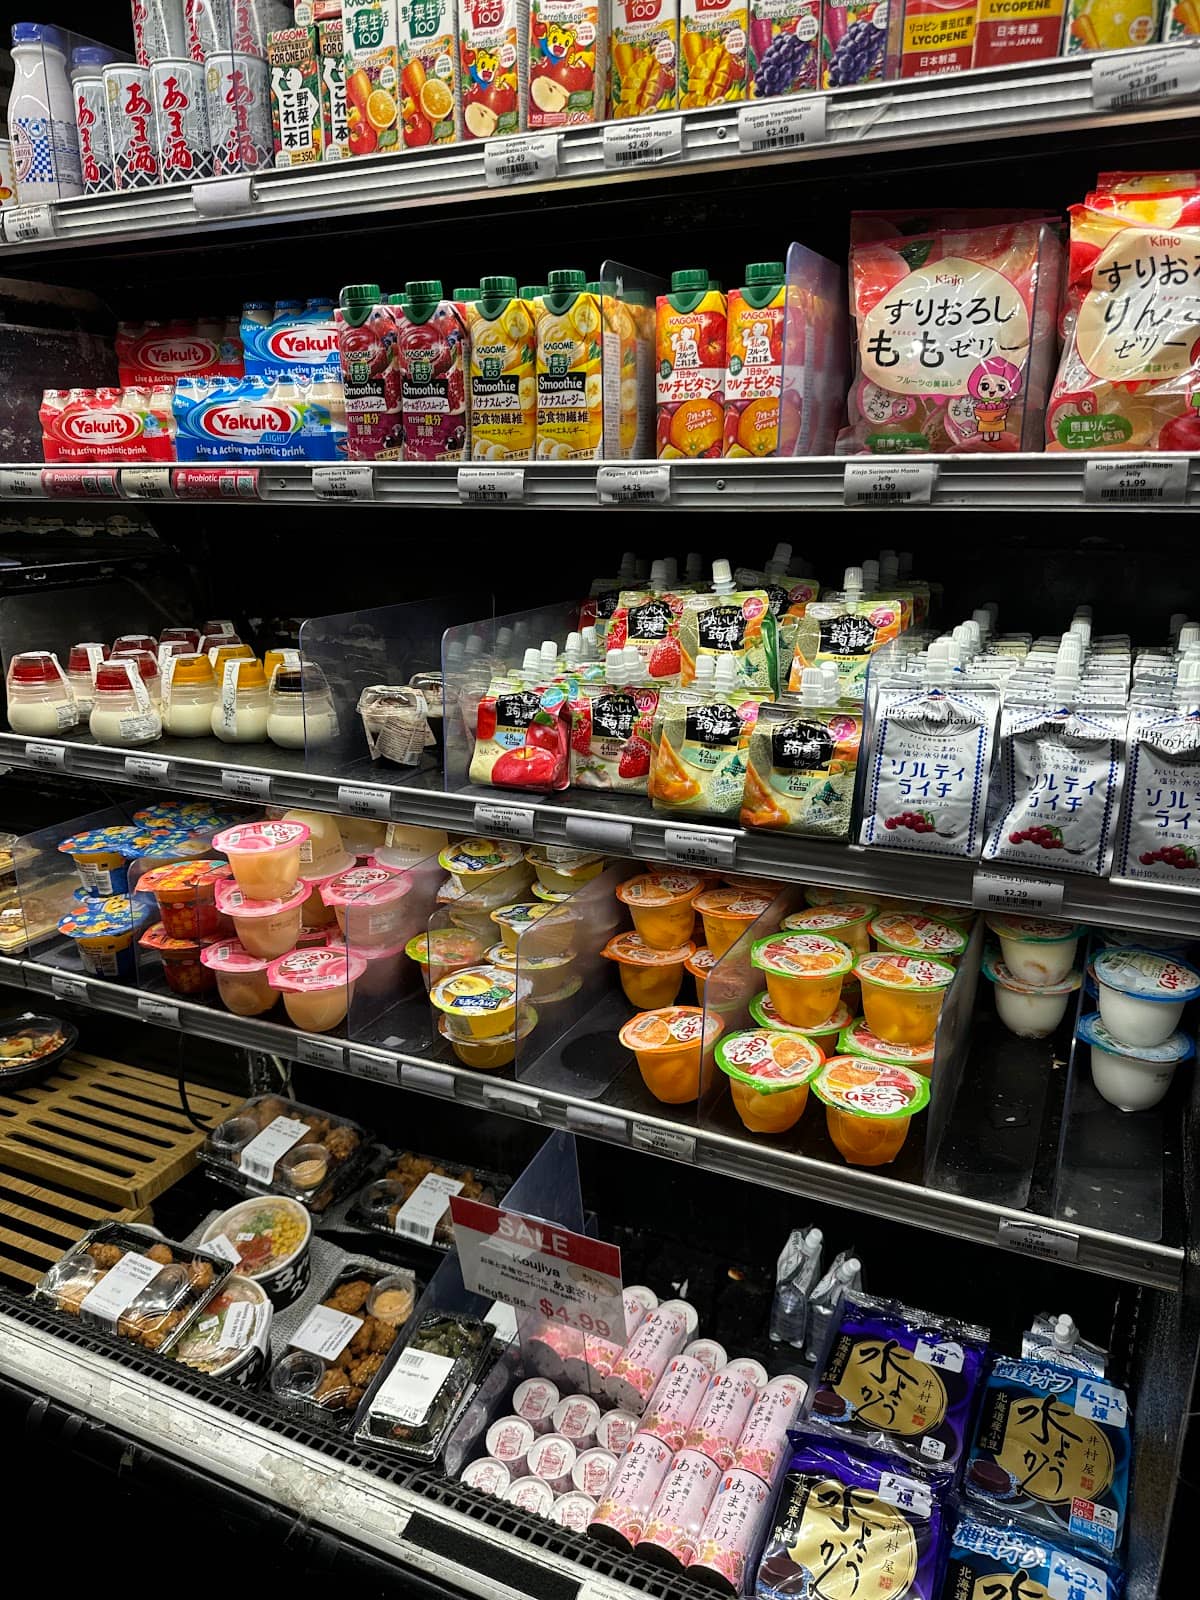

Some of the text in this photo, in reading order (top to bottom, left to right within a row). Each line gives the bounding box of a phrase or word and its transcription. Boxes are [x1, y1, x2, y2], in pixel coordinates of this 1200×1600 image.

[631, 4, 656, 19] 100
[989, 0, 1051, 13] LYCOPENE
[477, 11, 501, 25] 100
[415, 21, 435, 33] 100
[909, 22, 938, 34] リコピン
[997, 23, 1040, 37] 日本制造
[272, 28, 308, 42] KAGOME
[358, 32, 379, 46] 100
[912, 31, 968, 46] LYCOPENE
[1015, 36, 1044, 47] JAPAN
[270, 49, 312, 65] FOR ONE DAY
[1128, 73, 1158, 89] $2.89
[162, 76, 193, 171] あま酒
[283, 93, 299, 149] これ一本
[296, 91, 311, 147] 野菜一日
[766, 126, 790, 138] $2.49
[627, 140, 650, 150] $2.49
[506, 153, 526, 164] $2.49
[1149, 235, 1181, 249] Kinjo
[934, 273, 965, 287] Kinjo
[740, 309, 779, 321] KAGOME
[884, 295, 1021, 327] すりおろし
[669, 314, 704, 326] KAGOME
[476, 345, 507, 354] KAGOME
[543, 342, 575, 351] KAGOME
[748, 347, 769, 356] フルーツ
[866, 329, 945, 369] もも
[1114, 333, 1187, 360] ゼリー
[150, 348, 200, 363] Yakult
[345, 350, 372, 359] KAGOME
[405, 350, 436, 358] KAGOME
[676, 352, 697, 360] フルーツ
[287, 366, 309, 376] Active
[310, 366, 340, 376] Probiot
[415, 373, 428, 381] 100
[485, 369, 499, 378] 100
[551, 366, 565, 375] 100
[354, 374, 367, 382] 100
[539, 376, 583, 390] Smoothie
[344, 382, 382, 396] Smoothie
[402, 381, 446, 396] Smoothie
[473, 379, 517, 393] Smoothie
[658, 379, 722, 394] マルチビタミン
[74, 420, 125, 434] Yakult
[216, 414, 278, 431] Yakult
[265, 433, 286, 443] LIGHT
[76, 448, 96, 456] Active
[97, 447, 127, 456] Probiotic
[127, 445, 147, 455] Drink
[196, 445, 212, 455] Live
[219, 445, 243, 455] Active
[243, 446, 281, 456] Probiotic
[281, 447, 305, 457] Drink
[54, 473, 81, 483] Probiotic
[188, 473, 218, 483] Probiotic
[1119, 478, 1146, 488] $1.99
[872, 482, 896, 491] $1.99
[601, 700, 636, 714] おいしい
[697, 749, 721, 761] 42kcal
[891, 759, 966, 782] ソルティ
[898, 778, 953, 799] ライチ
[1024, 773, 1097, 796] ソルティ
[1027, 792, 1084, 813] ライチ
[1003, 889, 1028, 898] $2.29
[497, 1216, 570, 1257] SALE
[512, 1253, 561, 1278] Koujiya
[553, 1280, 599, 1303] あまざけ
[539, 1297, 611, 1338] $4.99
[630, 1315, 662, 1360] あまざけ
[658, 1361, 689, 1413] あまざけ
[702, 1375, 732, 1427] あまざけ
[911, 1379, 935, 1417] 井村屋
[1079, 1383, 1123, 1412] 4コ入
[1080, 1434, 1099, 1477] 井村屋
[611, 1440, 646, 1499] あまざけ
[657, 1457, 690, 1517] あまざけ
[713, 1478, 745, 1541] あまざけ
[880, 1520, 904, 1576] 井村屋
